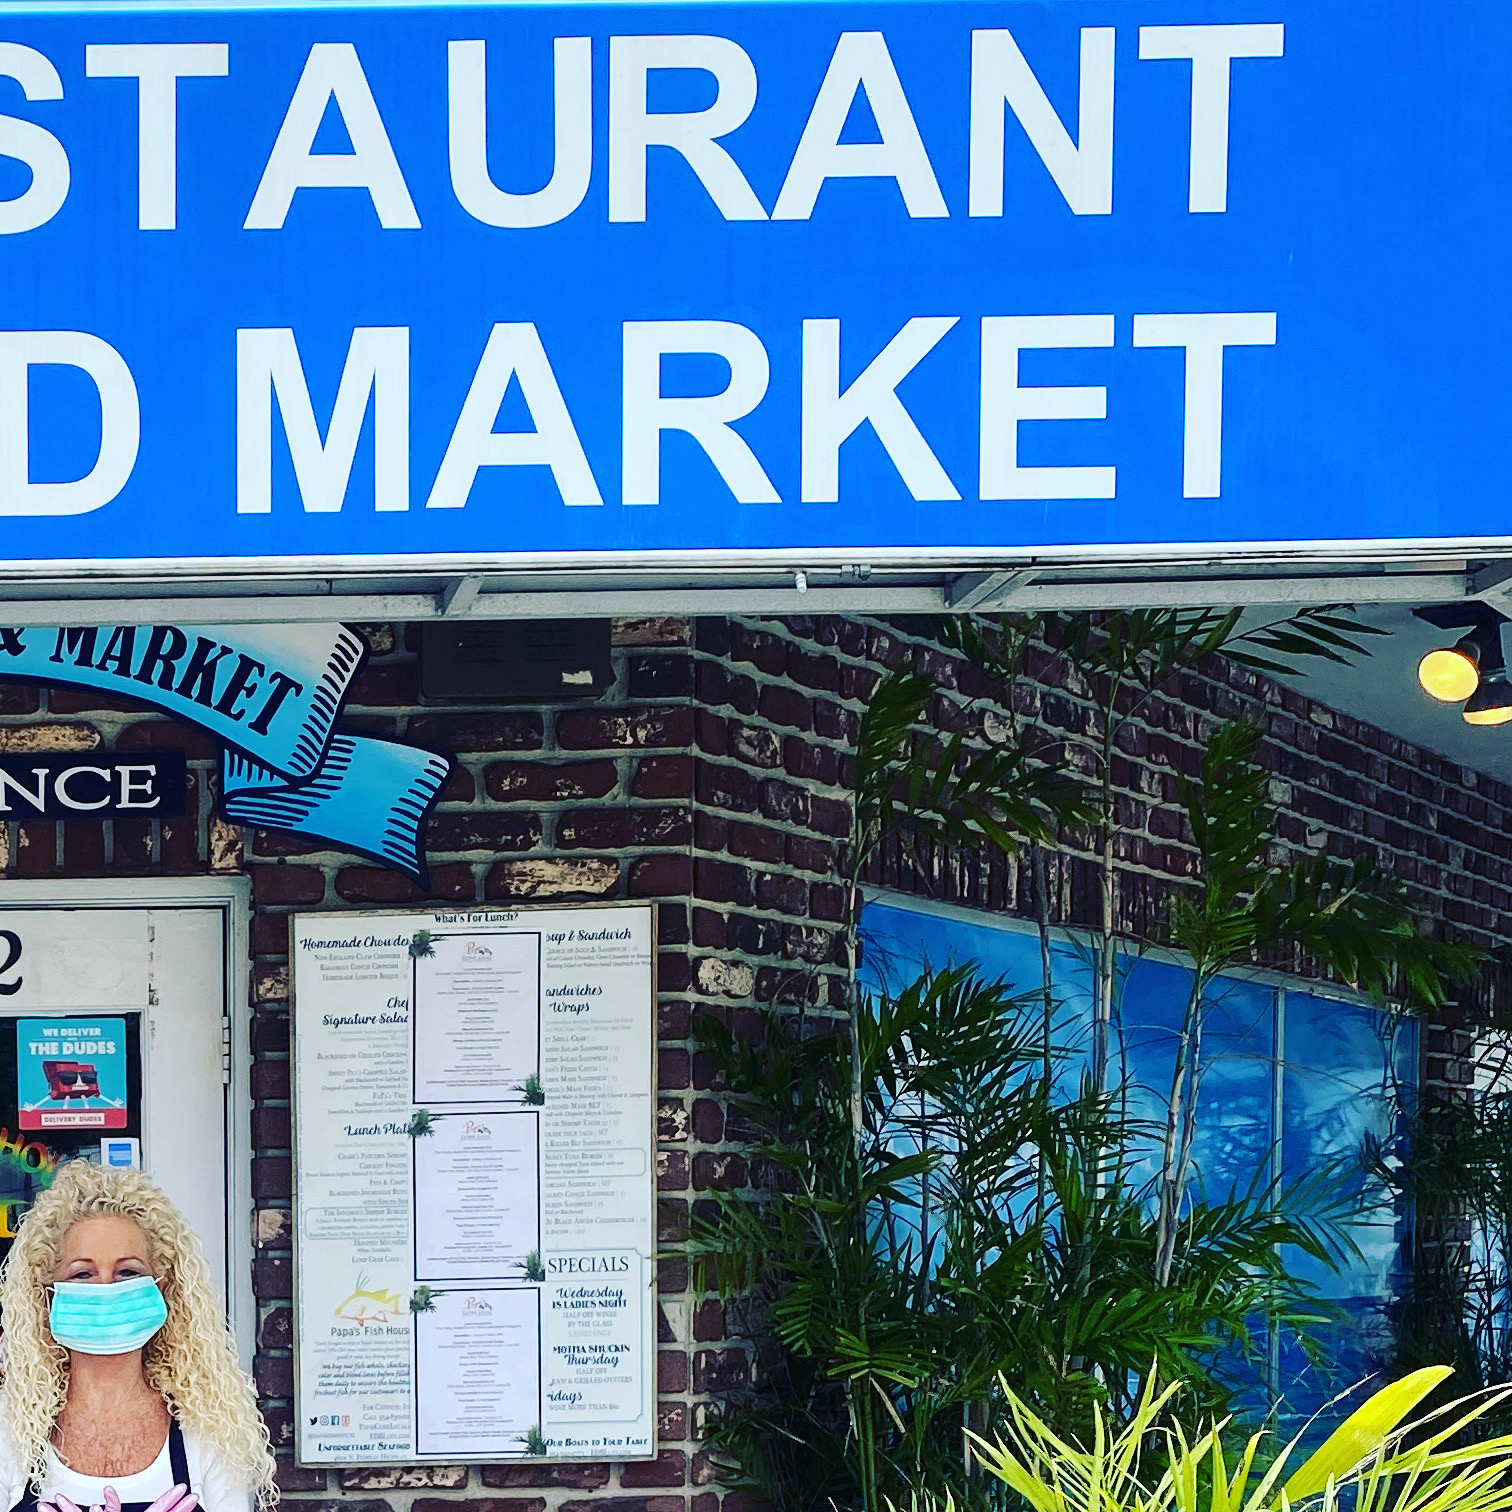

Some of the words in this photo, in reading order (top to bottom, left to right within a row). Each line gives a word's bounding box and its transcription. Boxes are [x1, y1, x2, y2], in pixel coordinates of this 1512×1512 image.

[235, 311, 1277, 515] MARKET
[49, 625, 303, 736] MARKET
[577, 927, 632, 941] Sandwich
[299, 936, 361, 951] Homemade
[549, 1001, 590, 1016] Wraps
[322, 1013, 377, 1029] Signature
[42, 1028, 60, 1037] WE
[61, 1027, 101, 1037] DELIVER
[28, 1041, 59, 1056] THE
[62, 1041, 116, 1055] DUDES
[44, 1115, 76, 1123] DELIVERY
[344, 1124, 381, 1136] Lunch
[548, 1256, 629, 1273] SPECIALS
[556, 1286, 624, 1302] Wednesday
[552, 1300, 562, 1309] IS
[331, 1327, 361, 1337] Papa's
[364, 1326, 384, 1336] Fish
[564, 1353, 619, 1368] Thursday
